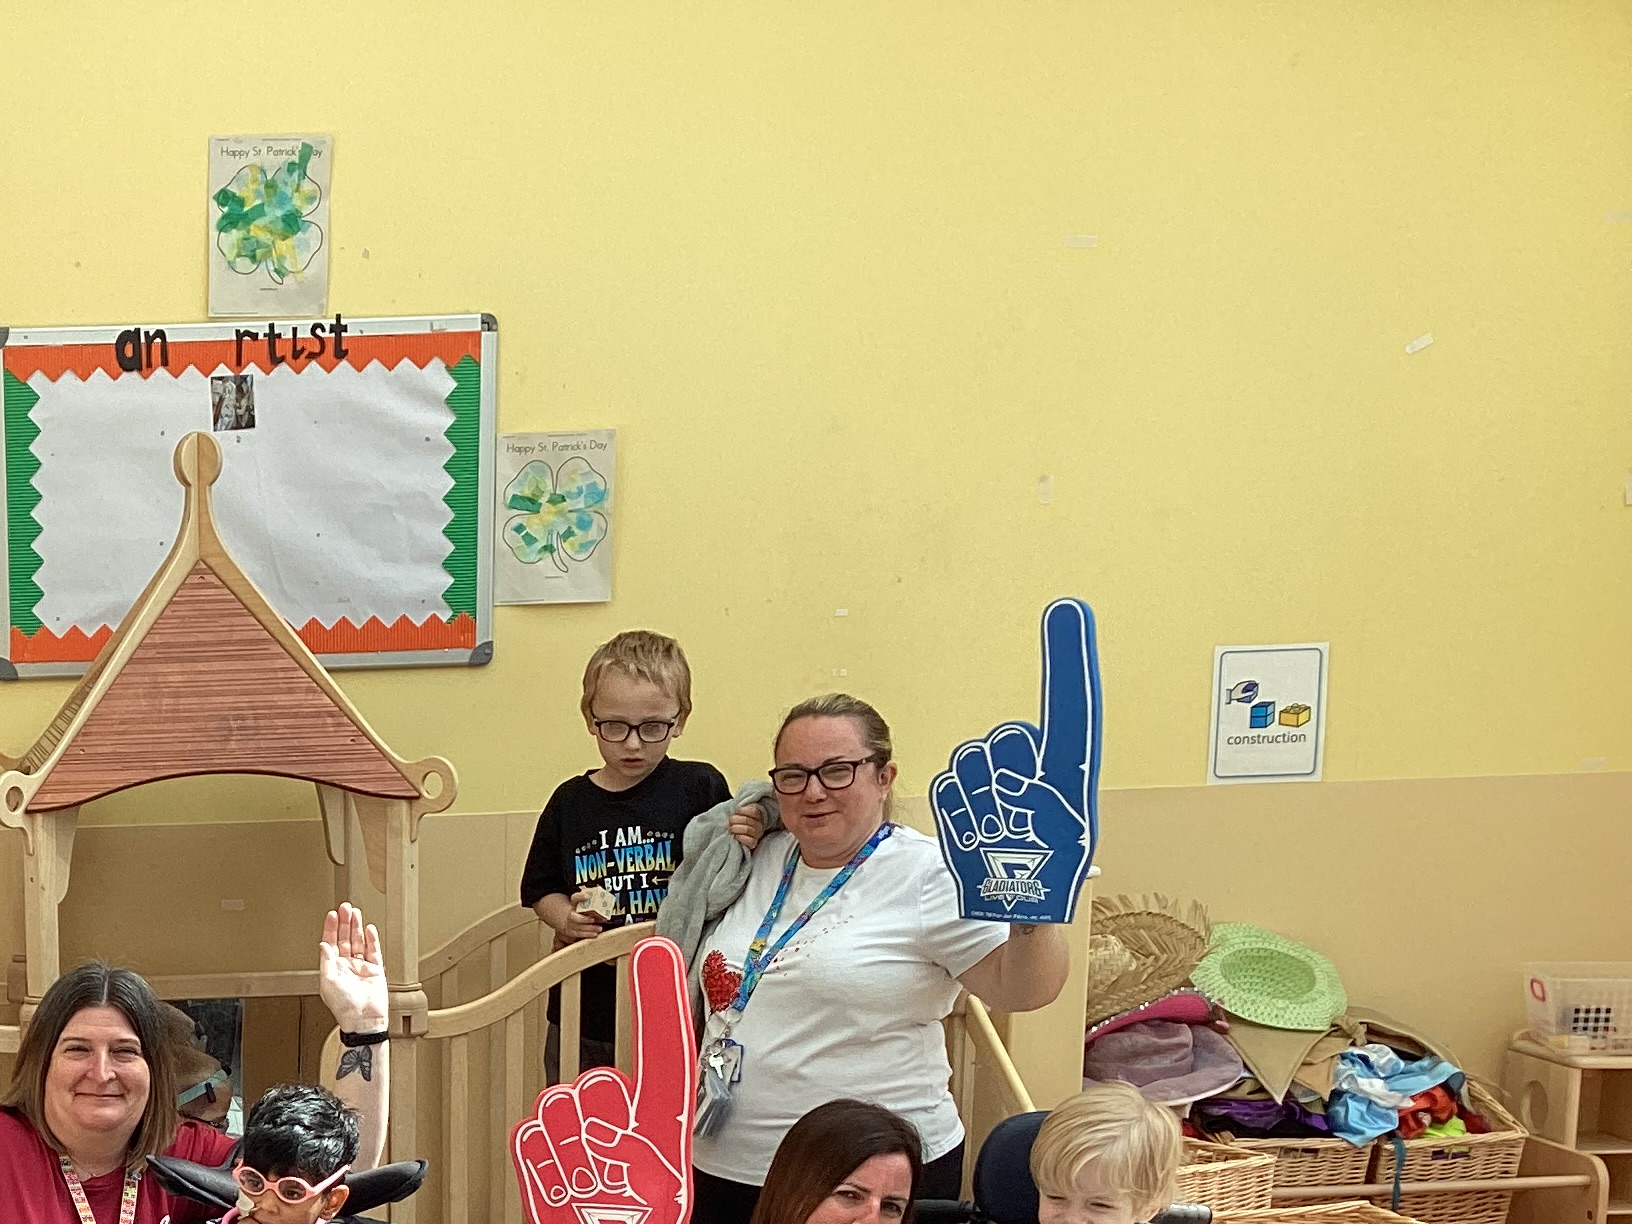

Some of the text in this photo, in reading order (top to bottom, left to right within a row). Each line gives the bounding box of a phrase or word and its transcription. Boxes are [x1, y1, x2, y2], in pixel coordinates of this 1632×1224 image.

[220, 146, 250, 160] Happy
[115, 313, 349, 372] an rtist
[506, 443, 535, 455] Happy
[589, 440, 608, 451] Day
[1227, 731, 1307, 745] construction
[599, 825, 655, 850] I AM...
[574, 839, 676, 885] NON-VERBAL
[604, 873, 649, 892] BUT I
[982, 880, 1042, 897] GLADIATORS
[629, 888, 669, 915] HAV
